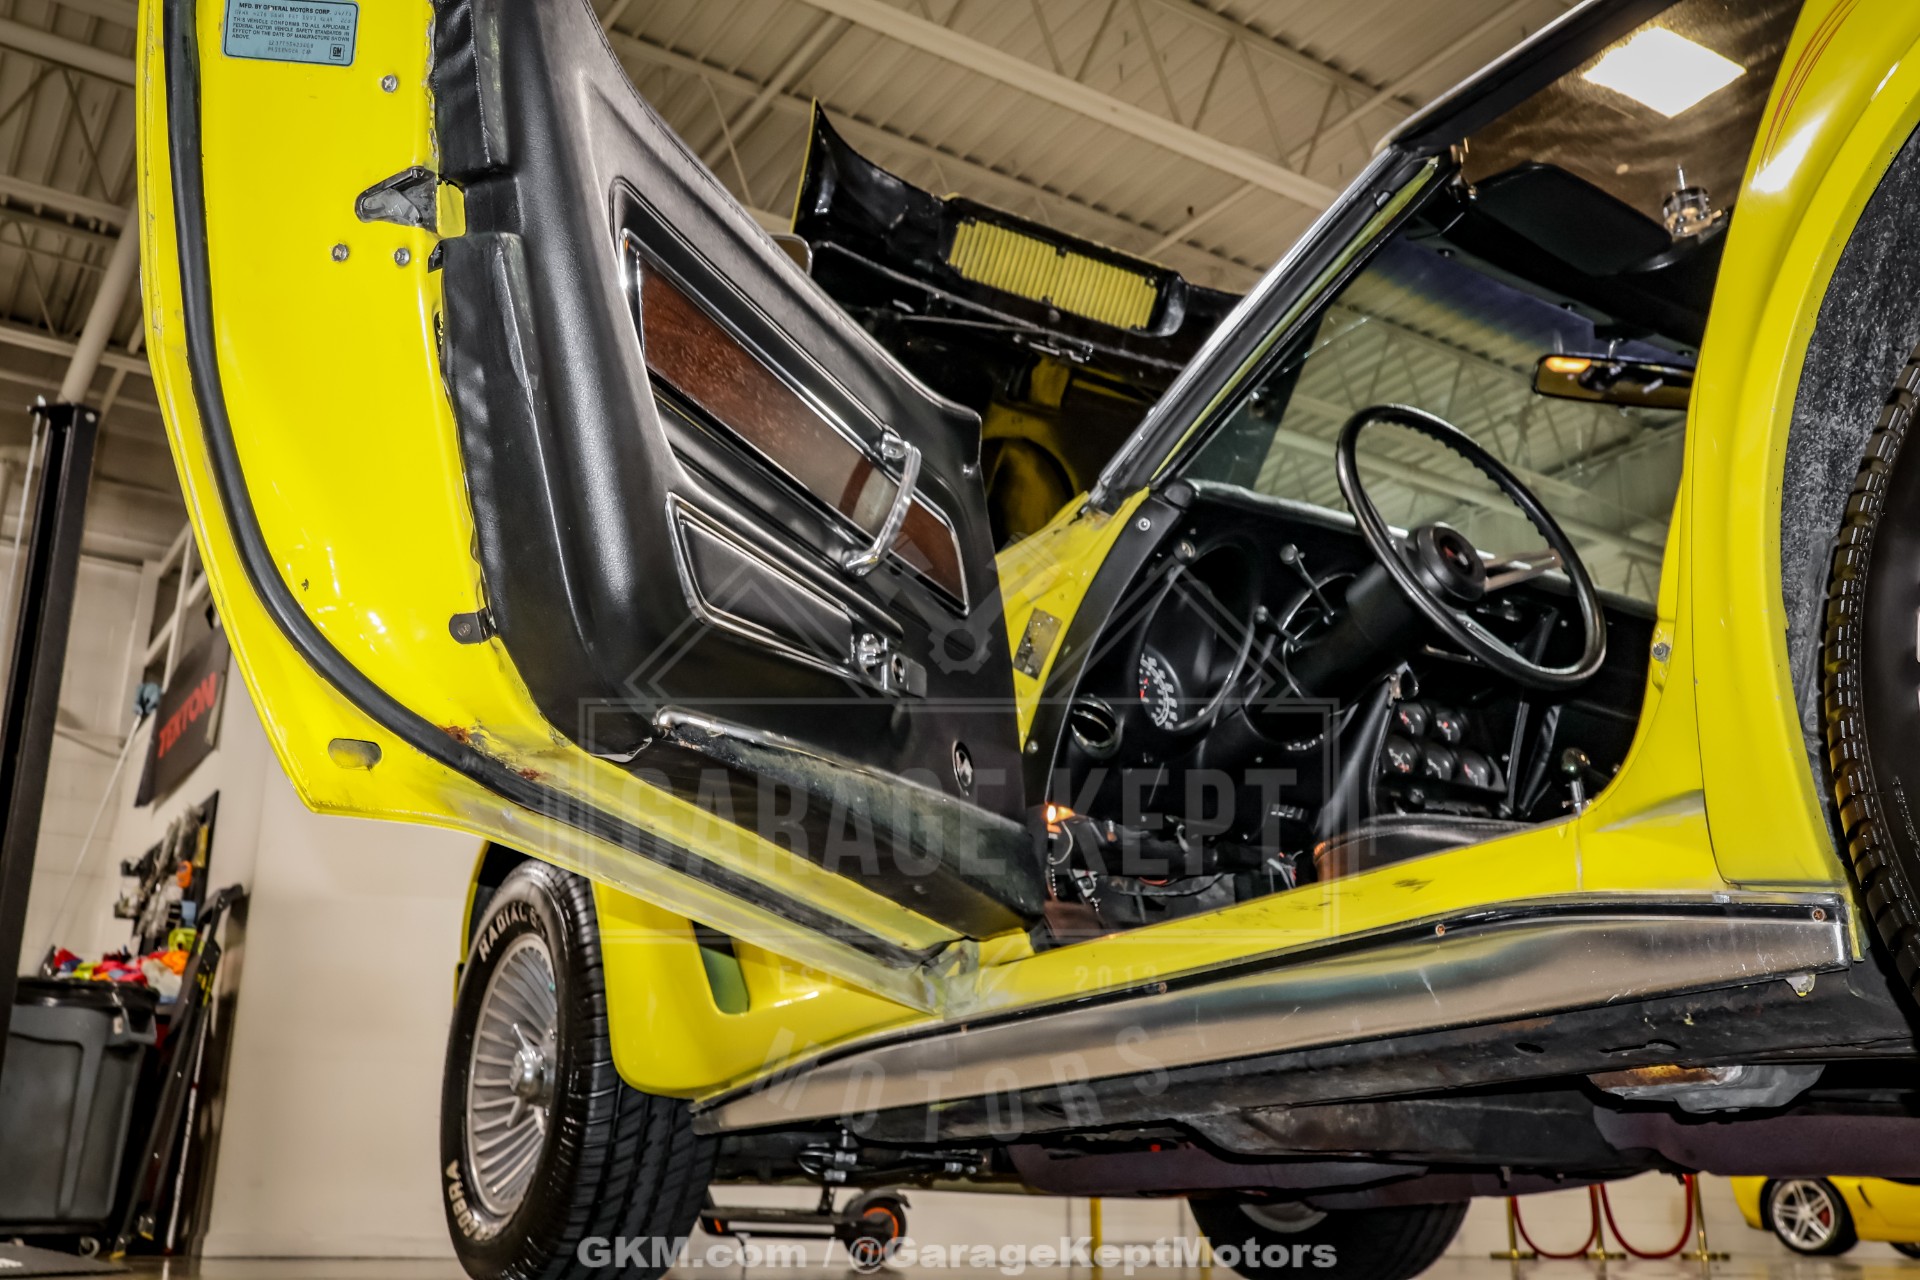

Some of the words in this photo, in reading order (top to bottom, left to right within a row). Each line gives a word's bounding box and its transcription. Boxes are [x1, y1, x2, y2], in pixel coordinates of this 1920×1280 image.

[332, 46, 342, 55] GM
[158, 671, 217, 760] TEKTON
[478, 901, 529, 964] RADIAL
[446, 1159, 480, 1238] COBRA
